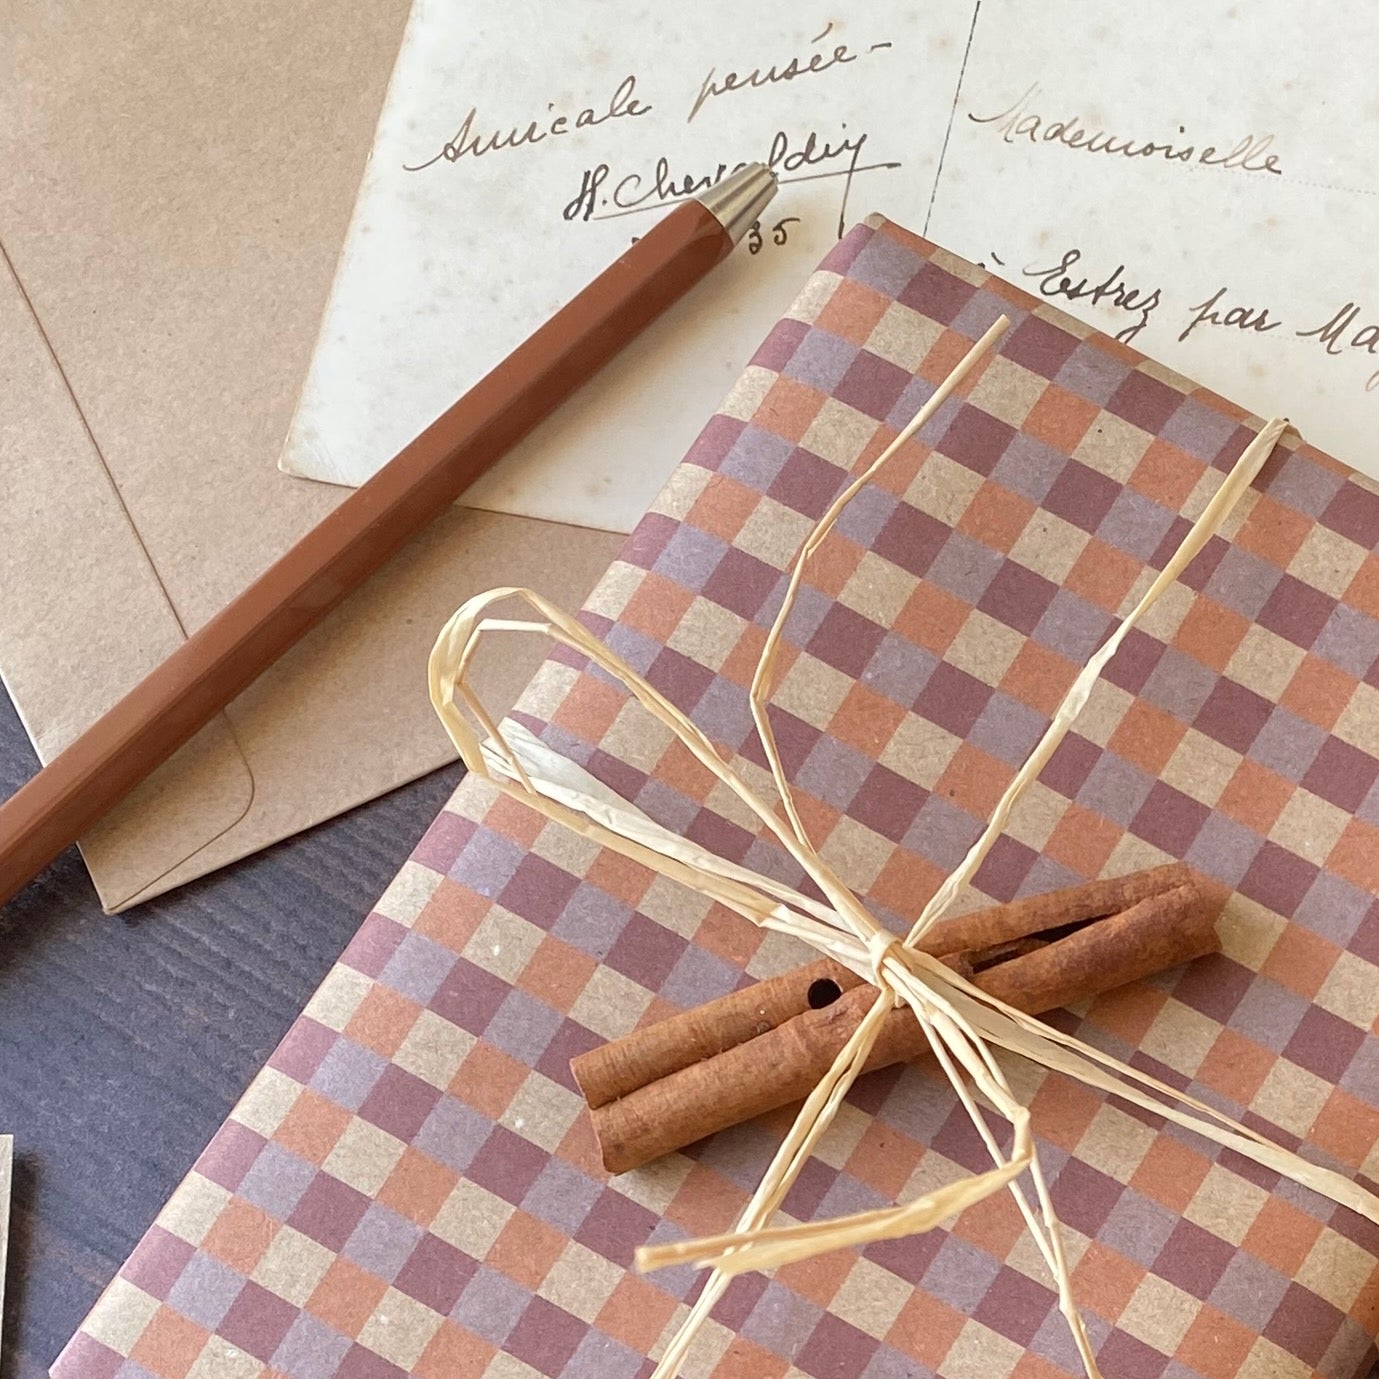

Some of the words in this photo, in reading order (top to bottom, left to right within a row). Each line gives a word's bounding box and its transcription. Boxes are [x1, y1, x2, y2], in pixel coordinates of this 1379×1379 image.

[402, 75, 653, 171] Amicale
[967, 80, 1283, 176] Mademoiselle
[1178, 287, 1283, 342] par
